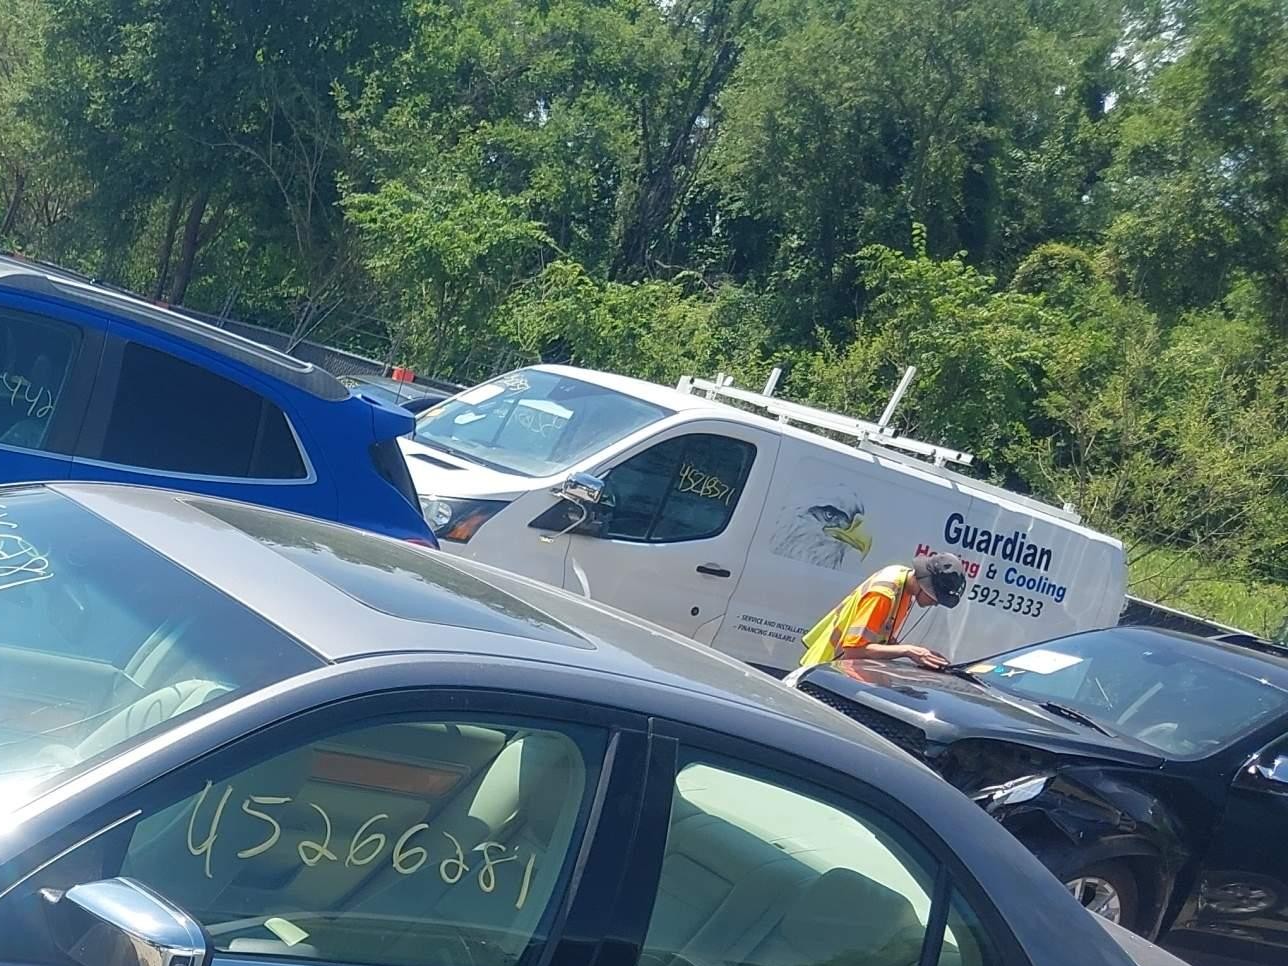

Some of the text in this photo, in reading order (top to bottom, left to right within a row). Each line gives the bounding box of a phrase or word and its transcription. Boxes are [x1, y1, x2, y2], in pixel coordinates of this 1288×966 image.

[944, 512, 1053, 572] Guardian
[986, 563, 1067, 602] & Cooling
[968, 584, 1044, 618] 592-3333
[737, 623, 768, 637] FINANCING
[742, 614, 764, 625] SERVICE
[187, 780, 537, 909] 45266281
